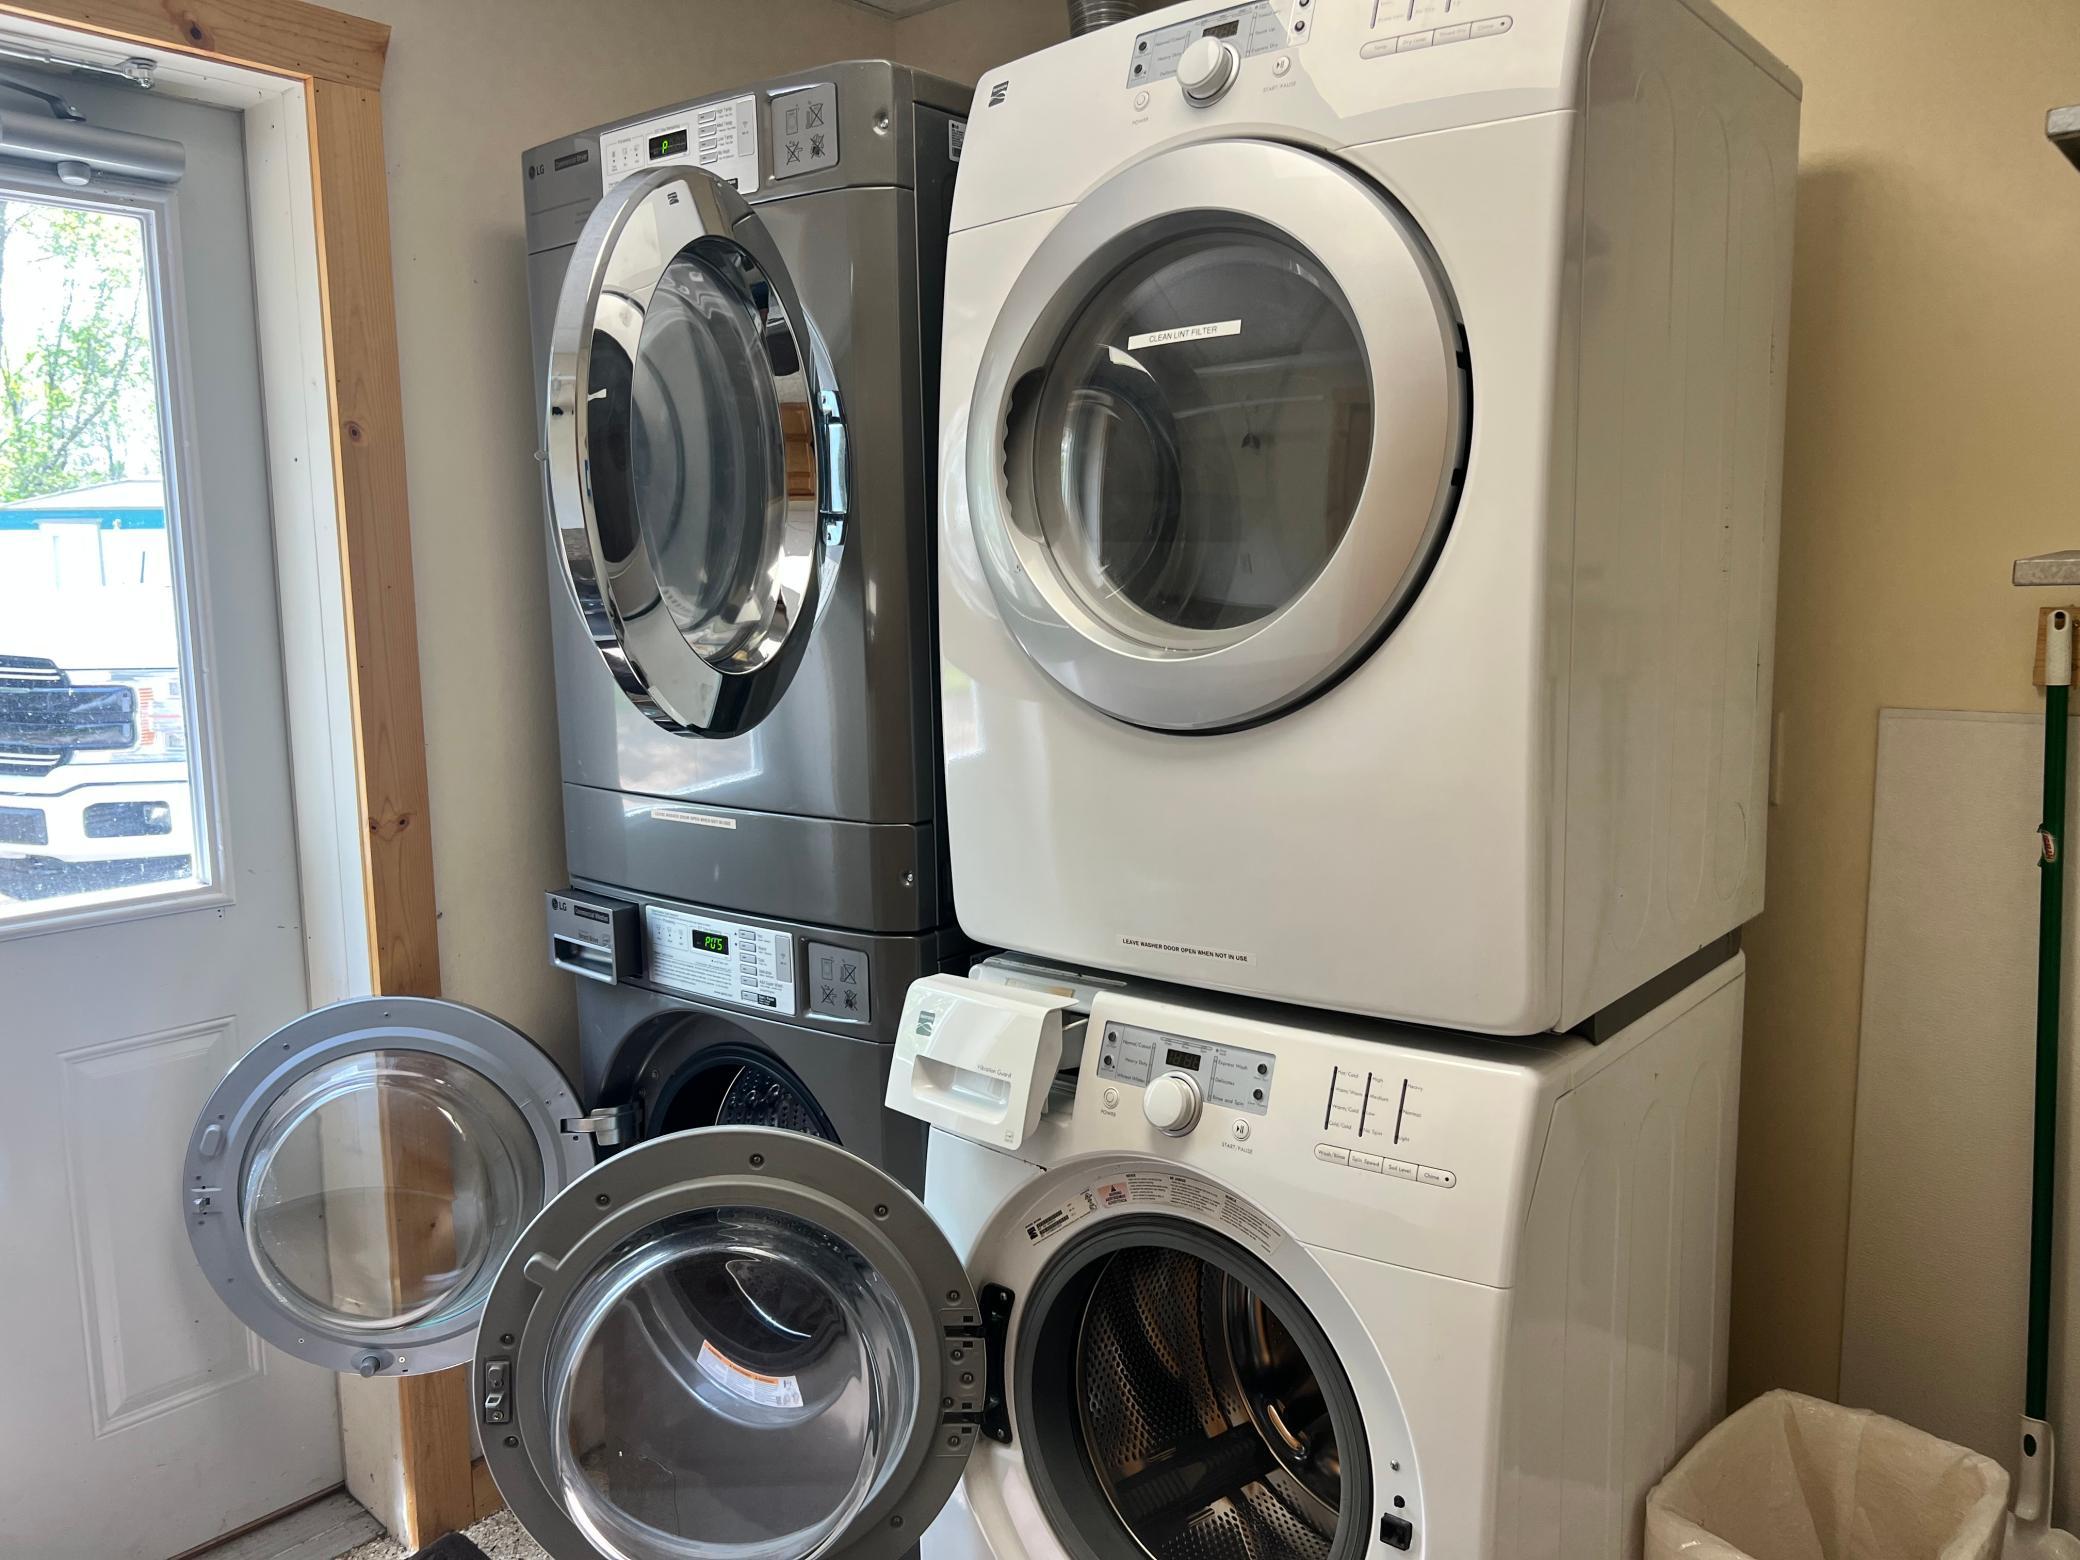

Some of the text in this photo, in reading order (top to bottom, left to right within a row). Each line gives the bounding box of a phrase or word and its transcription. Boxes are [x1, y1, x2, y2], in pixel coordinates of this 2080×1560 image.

[661, 140, 668, 154] P
[537, 164, 545, 176] LG
[1149, 326, 1218, 343] CLEAN LINT FILTER
[559, 902, 567, 911] LG
[1122, 938, 1139, 946] LEAVE
[1140, 941, 1163, 950] WASHER
[1163, 944, 1180, 952] DOOR
[1180, 947, 1197, 955] OPEN
[1101, 1109, 1117, 1118] POWER
[1318, 1150, 1346, 1160] Wash/Rinse
[1352, 1155, 1380, 1168] Spin Speed
[1398, 1165, 1411, 1174] Level
[1424, 1172, 1440, 1181] Chime
